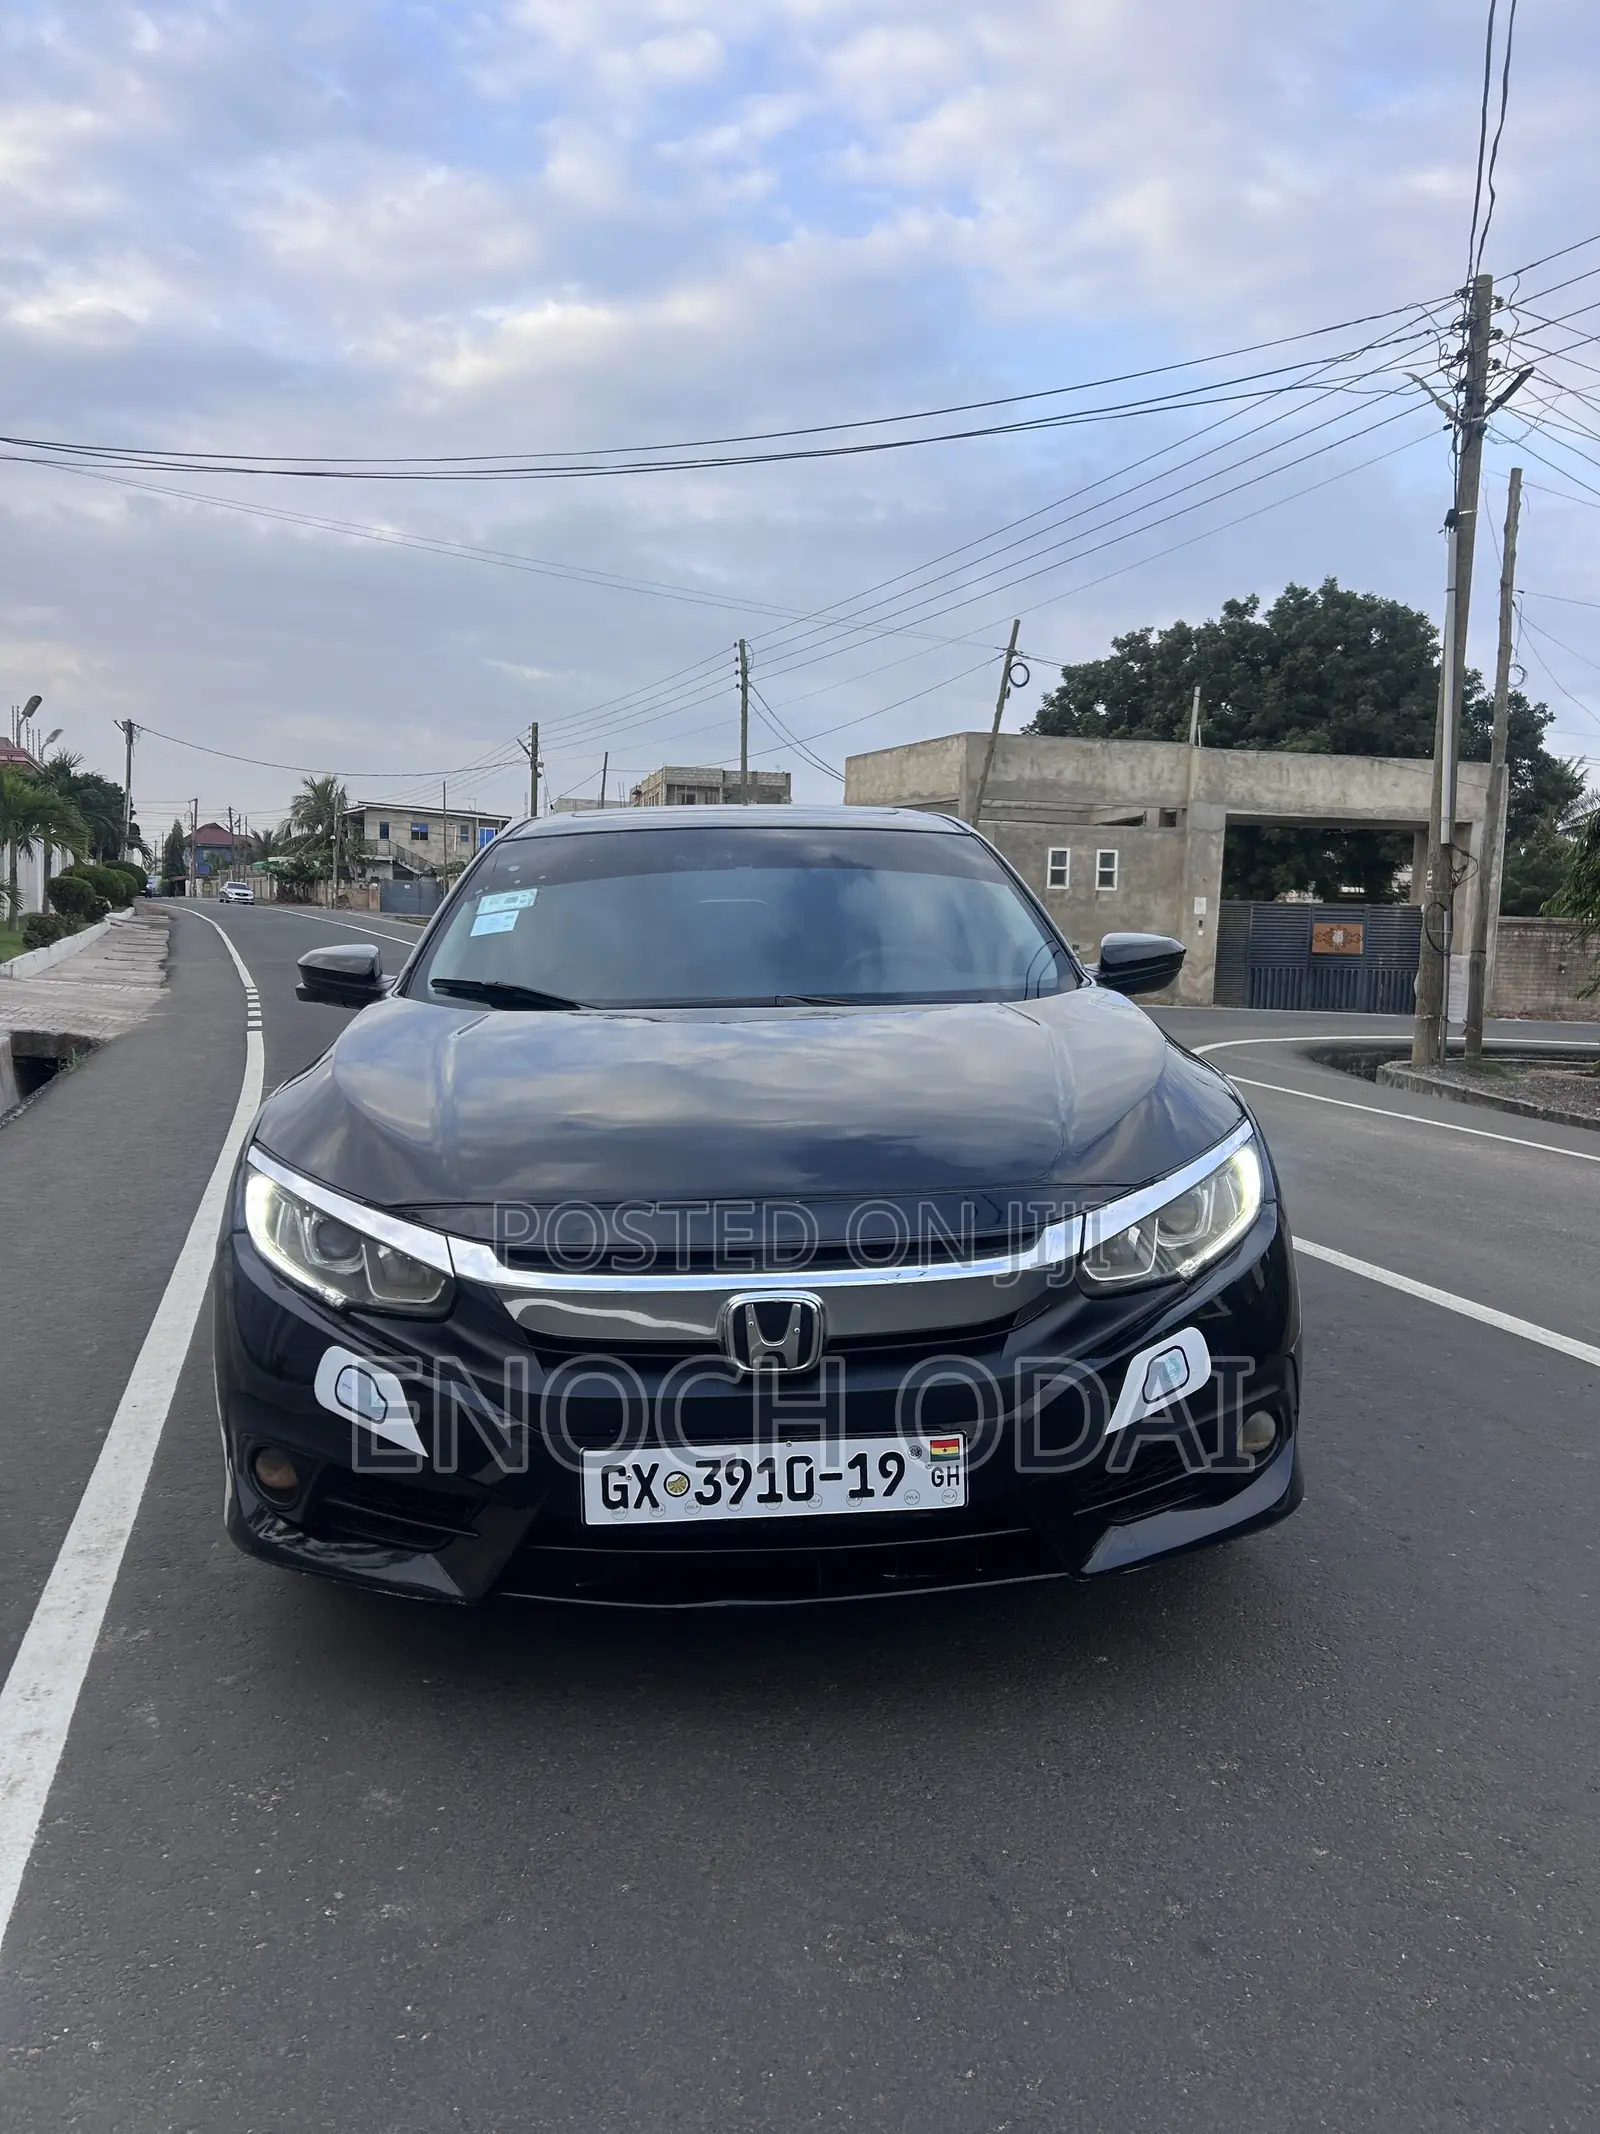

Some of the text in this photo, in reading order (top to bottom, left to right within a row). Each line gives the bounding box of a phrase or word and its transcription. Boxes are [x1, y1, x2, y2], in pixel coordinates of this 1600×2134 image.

[601, 1451, 906, 1510] GX 3910-19
[931, 1464, 960, 1488] GH
